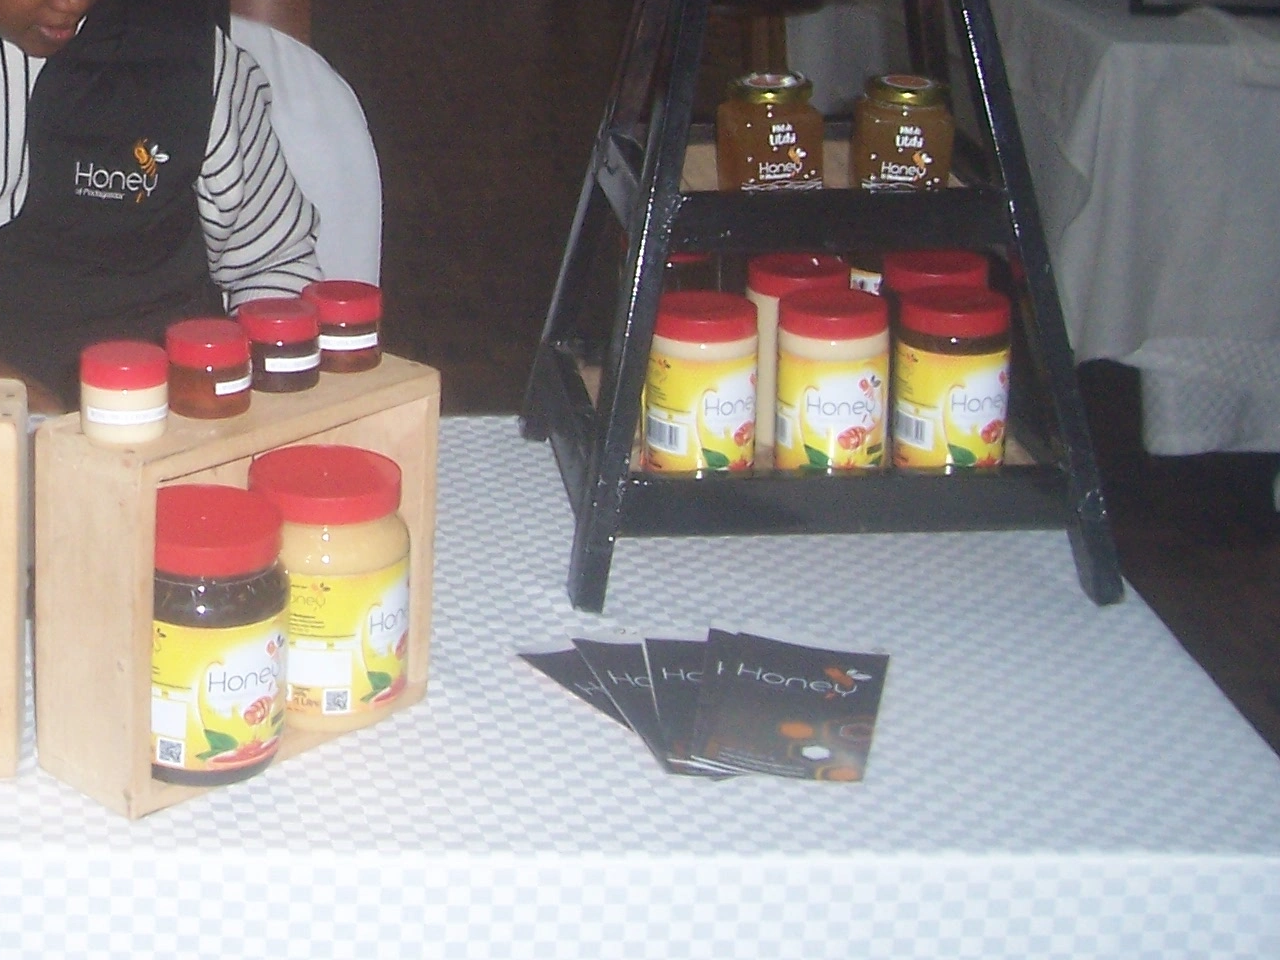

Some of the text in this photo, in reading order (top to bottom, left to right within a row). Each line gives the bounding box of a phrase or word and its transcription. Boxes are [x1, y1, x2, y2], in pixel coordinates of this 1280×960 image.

[74, 161, 158, 197] Honey
[759, 161, 803, 175] Honey
[881, 161, 927, 179] Honey
[704, 395, 754, 417] Hone
[806, 394, 875, 417] Honey
[951, 392, 1006, 413] Hone
[291, 593, 326, 611] oney
[369, 607, 408, 636] Hon
[737, 662, 857, 697] Honey
